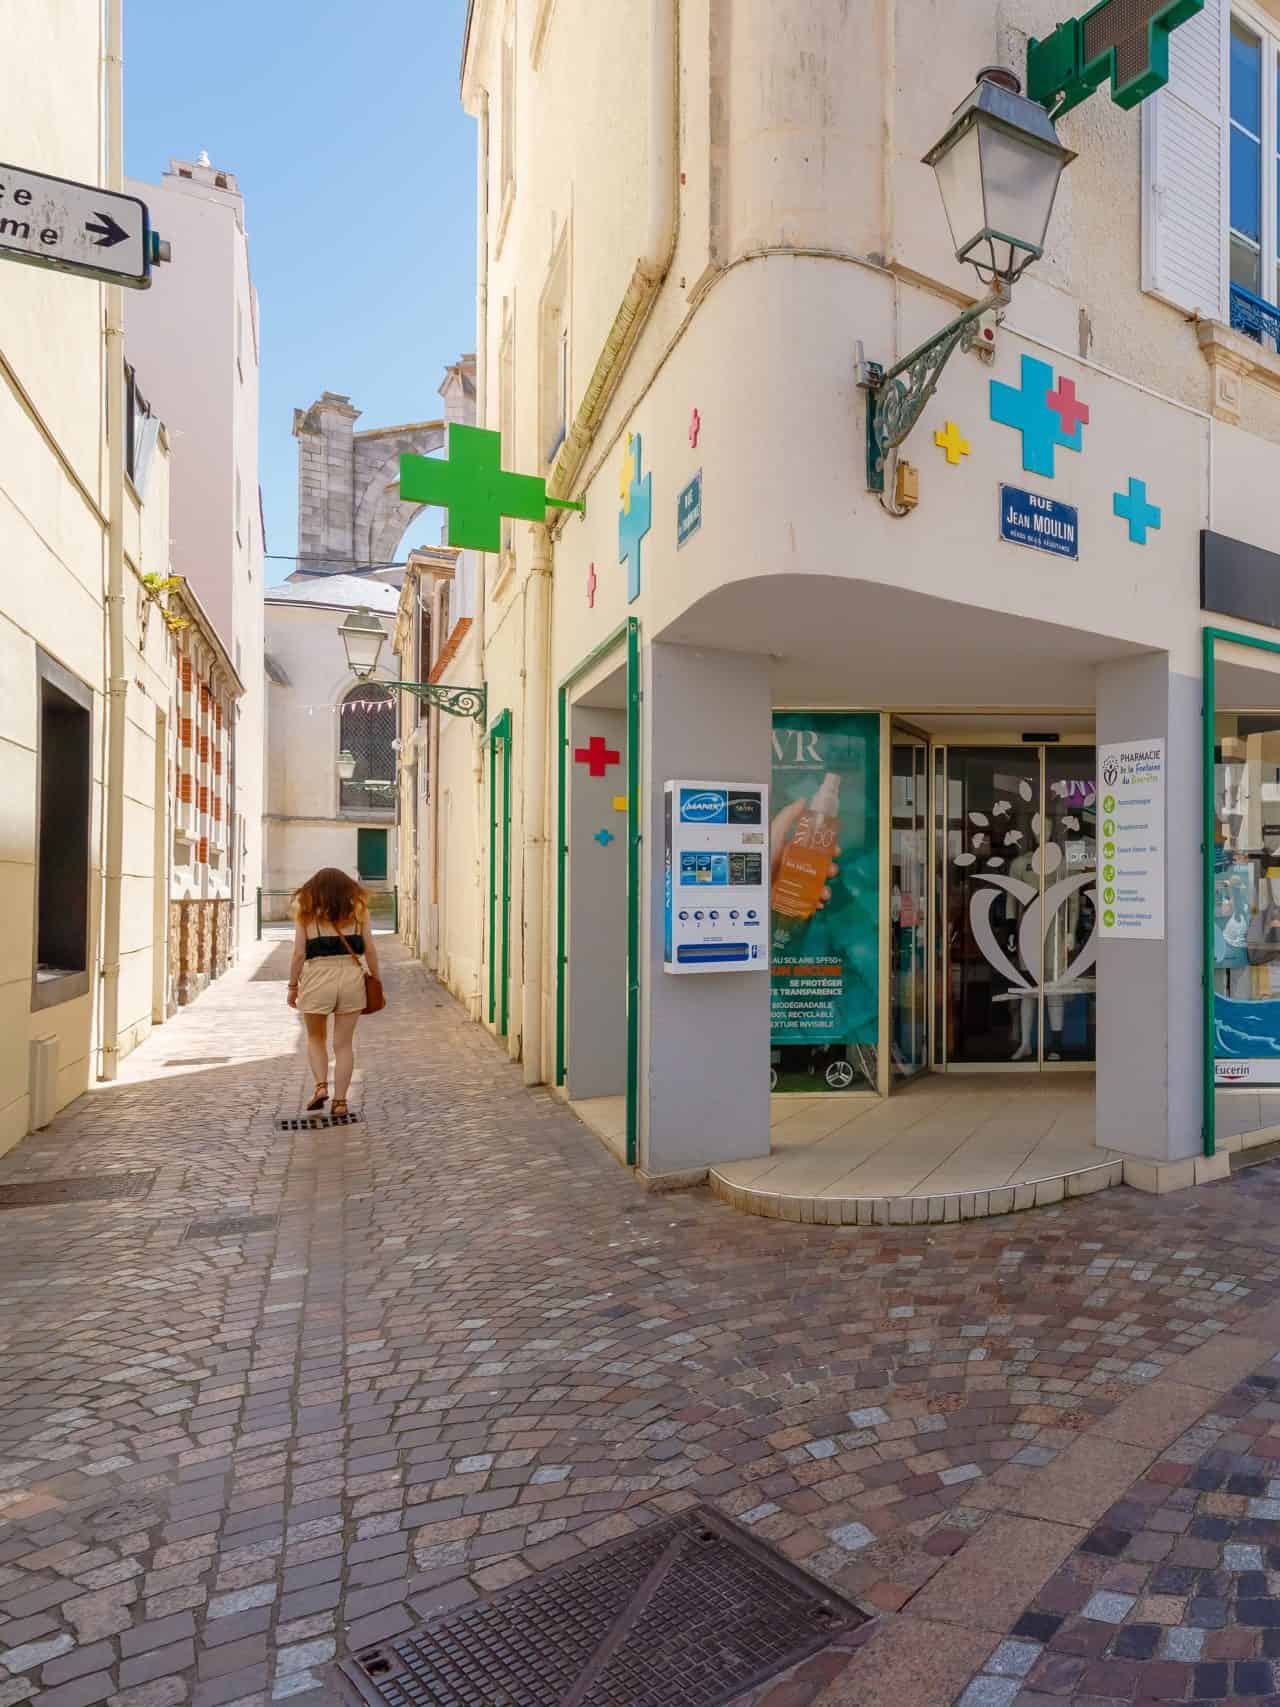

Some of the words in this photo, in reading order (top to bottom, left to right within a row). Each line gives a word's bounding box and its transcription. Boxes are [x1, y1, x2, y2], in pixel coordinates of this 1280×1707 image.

[1029, 495, 1053, 512] RUE
[1007, 505, 1030, 529] JEAN
[1033, 513, 1075, 543] MOULIN
[770, 730, 824, 762] VR
[1120, 750, 1160, 761] PHARMACIE
[801, 978, 842, 987] PROTÉGER
[1216, 1064, 1249, 1074] Eucerin
